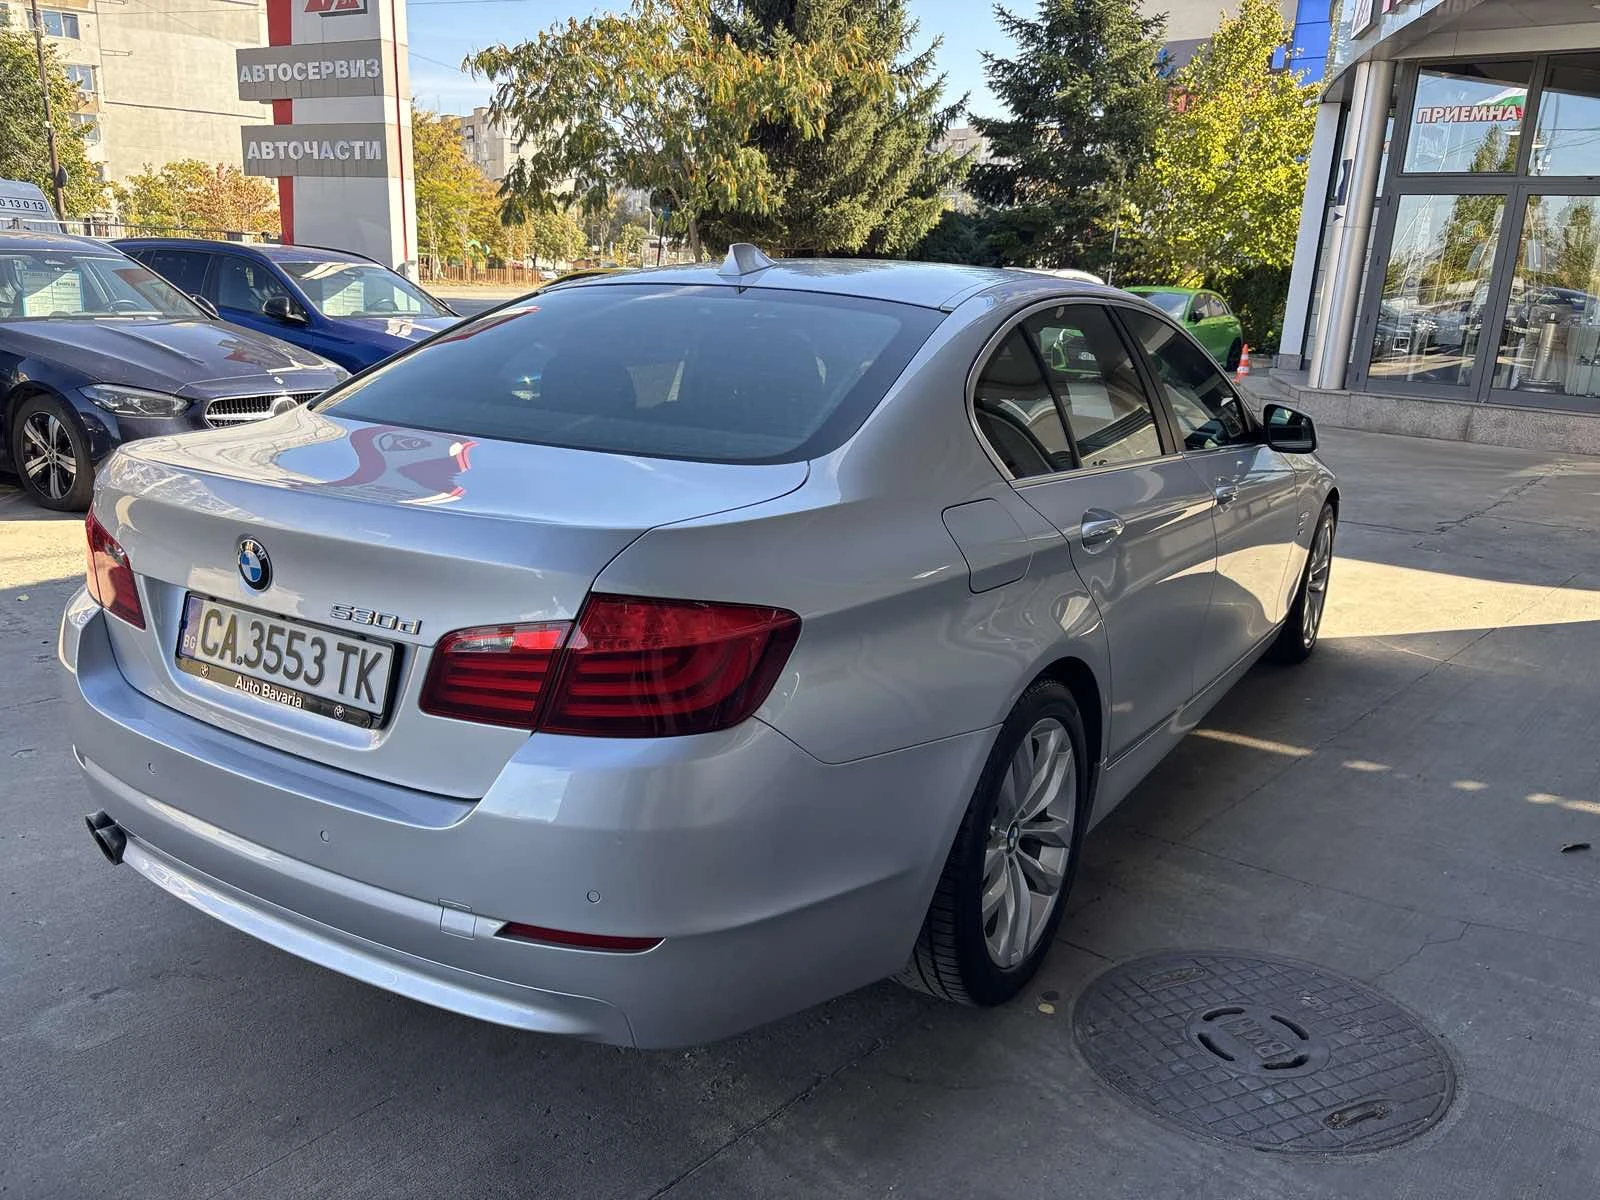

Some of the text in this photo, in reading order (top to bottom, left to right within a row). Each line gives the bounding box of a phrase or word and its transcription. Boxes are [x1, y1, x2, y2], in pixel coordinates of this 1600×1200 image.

[239, 57, 381, 83] АВТОСЕРВИЗ
[1416, 105, 1518, 124] ПРИЕМНА
[247, 139, 382, 161] АВТОЧАСТИ
[9, 199, 21, 208] 13
[23, 200, 30, 209] 0
[32, 201, 44, 210] 13
[329, 601, 422, 635] 530d
[183, 634, 197, 649] BG
[234, 676, 303, 708] Auto Bavaria
